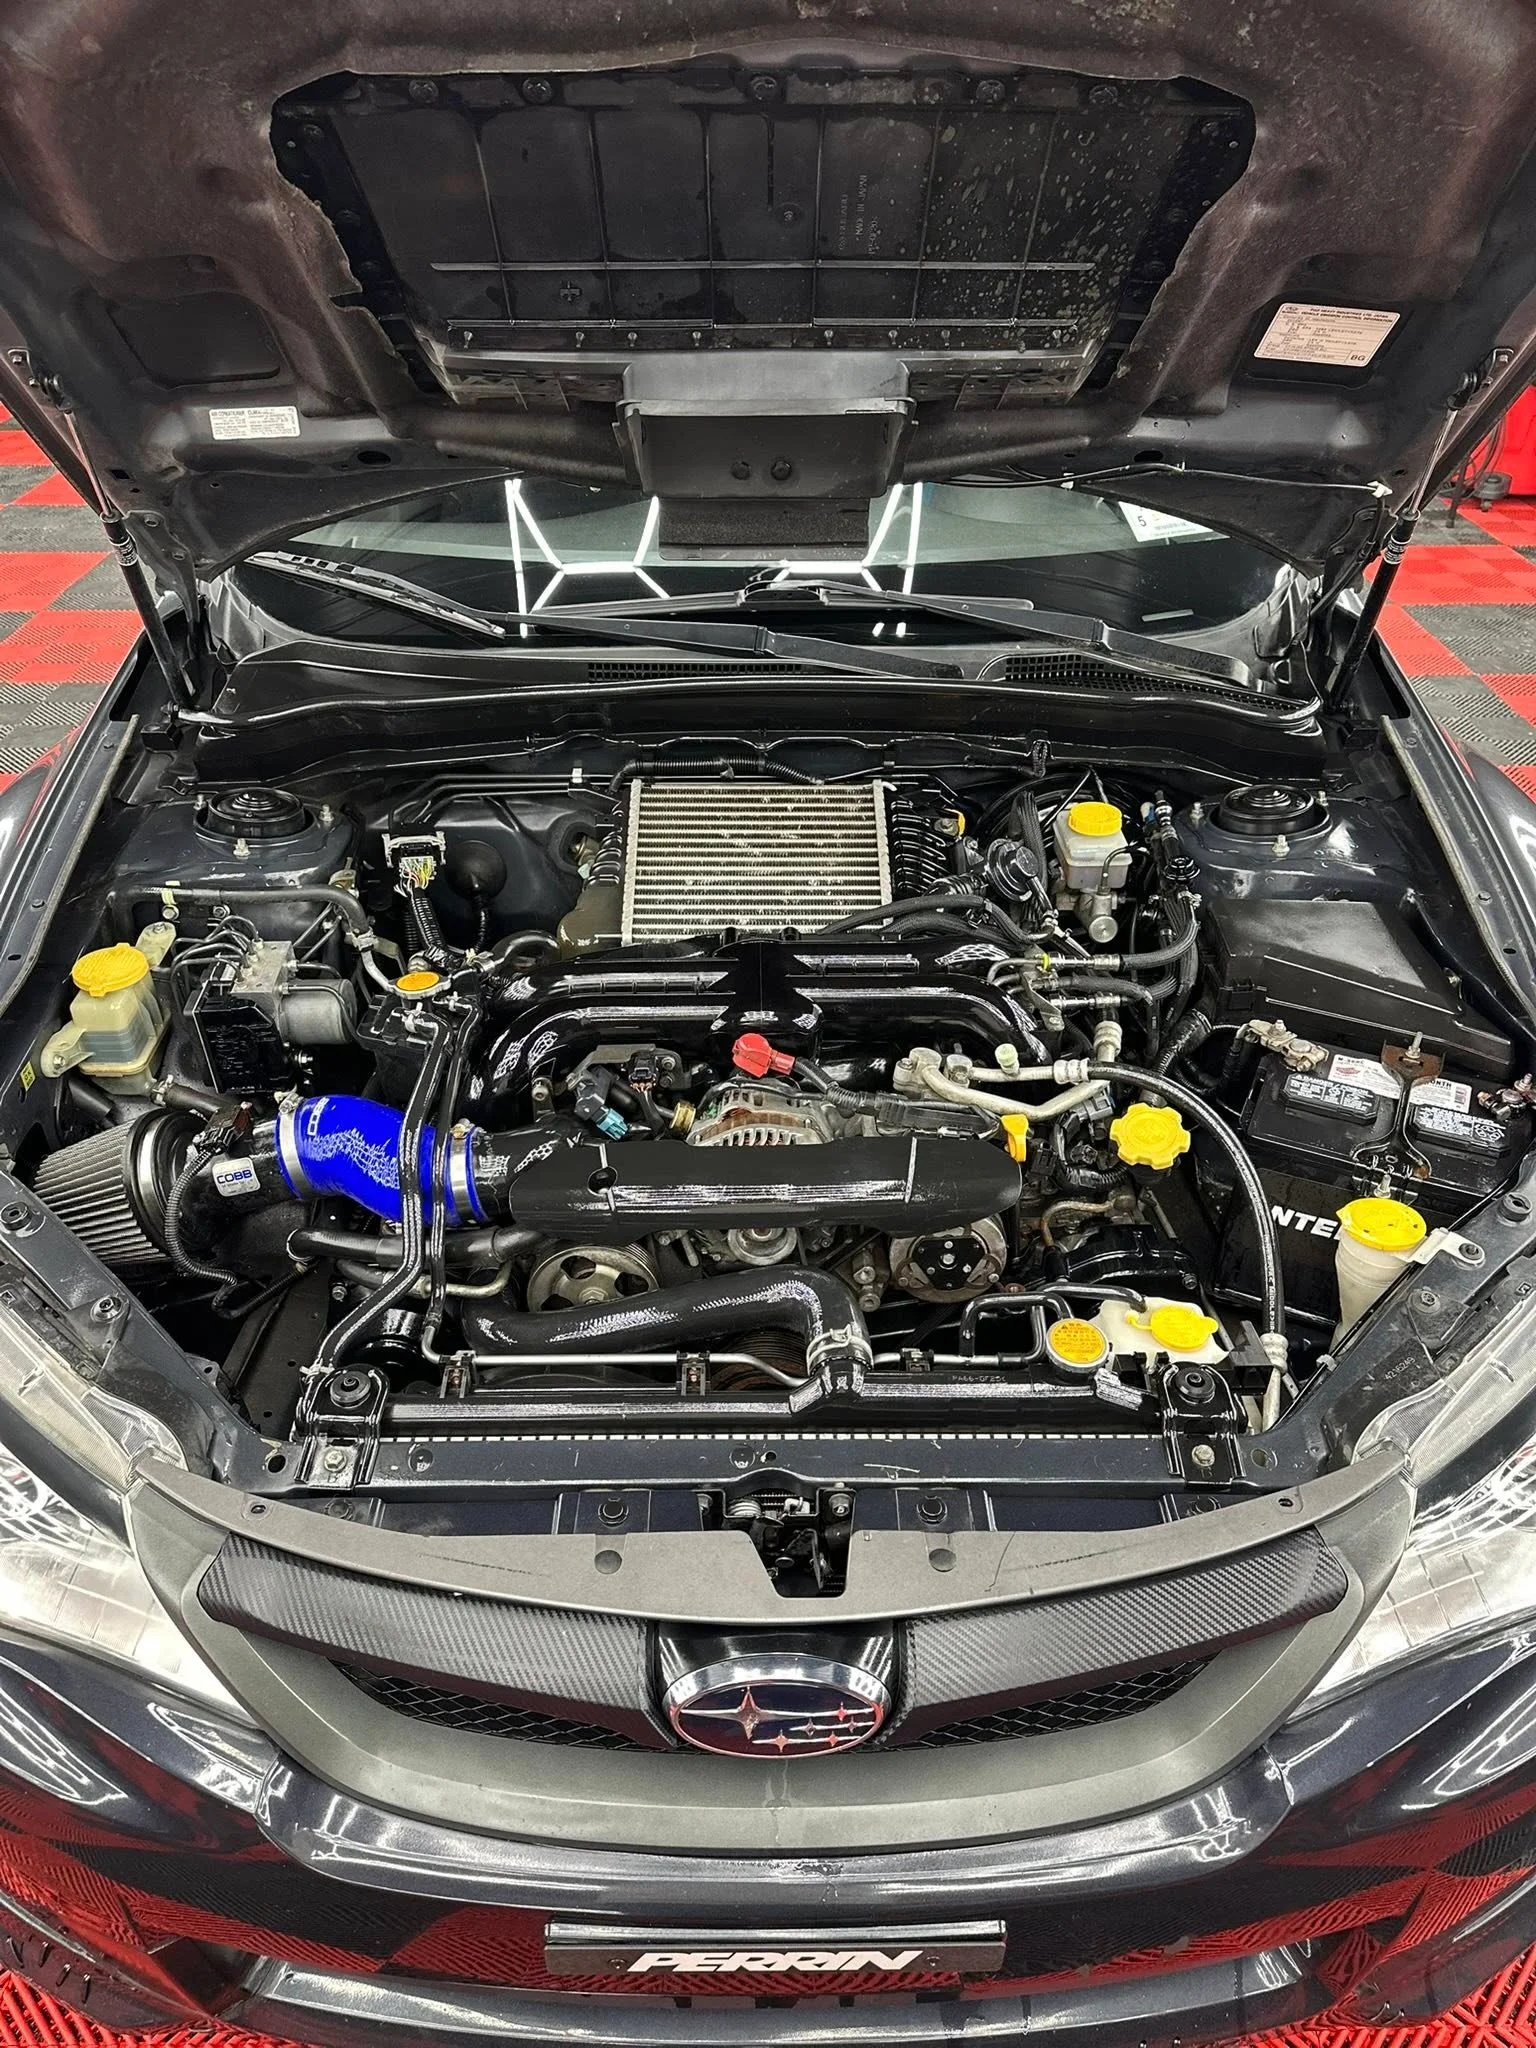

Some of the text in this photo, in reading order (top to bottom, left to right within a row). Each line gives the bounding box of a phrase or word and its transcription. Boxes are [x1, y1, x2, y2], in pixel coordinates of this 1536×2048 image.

[307, 1097, 330, 1136] COBB
[216, 1169, 253, 1184] COBB
[627, 1949, 923, 1973] PERRIN
